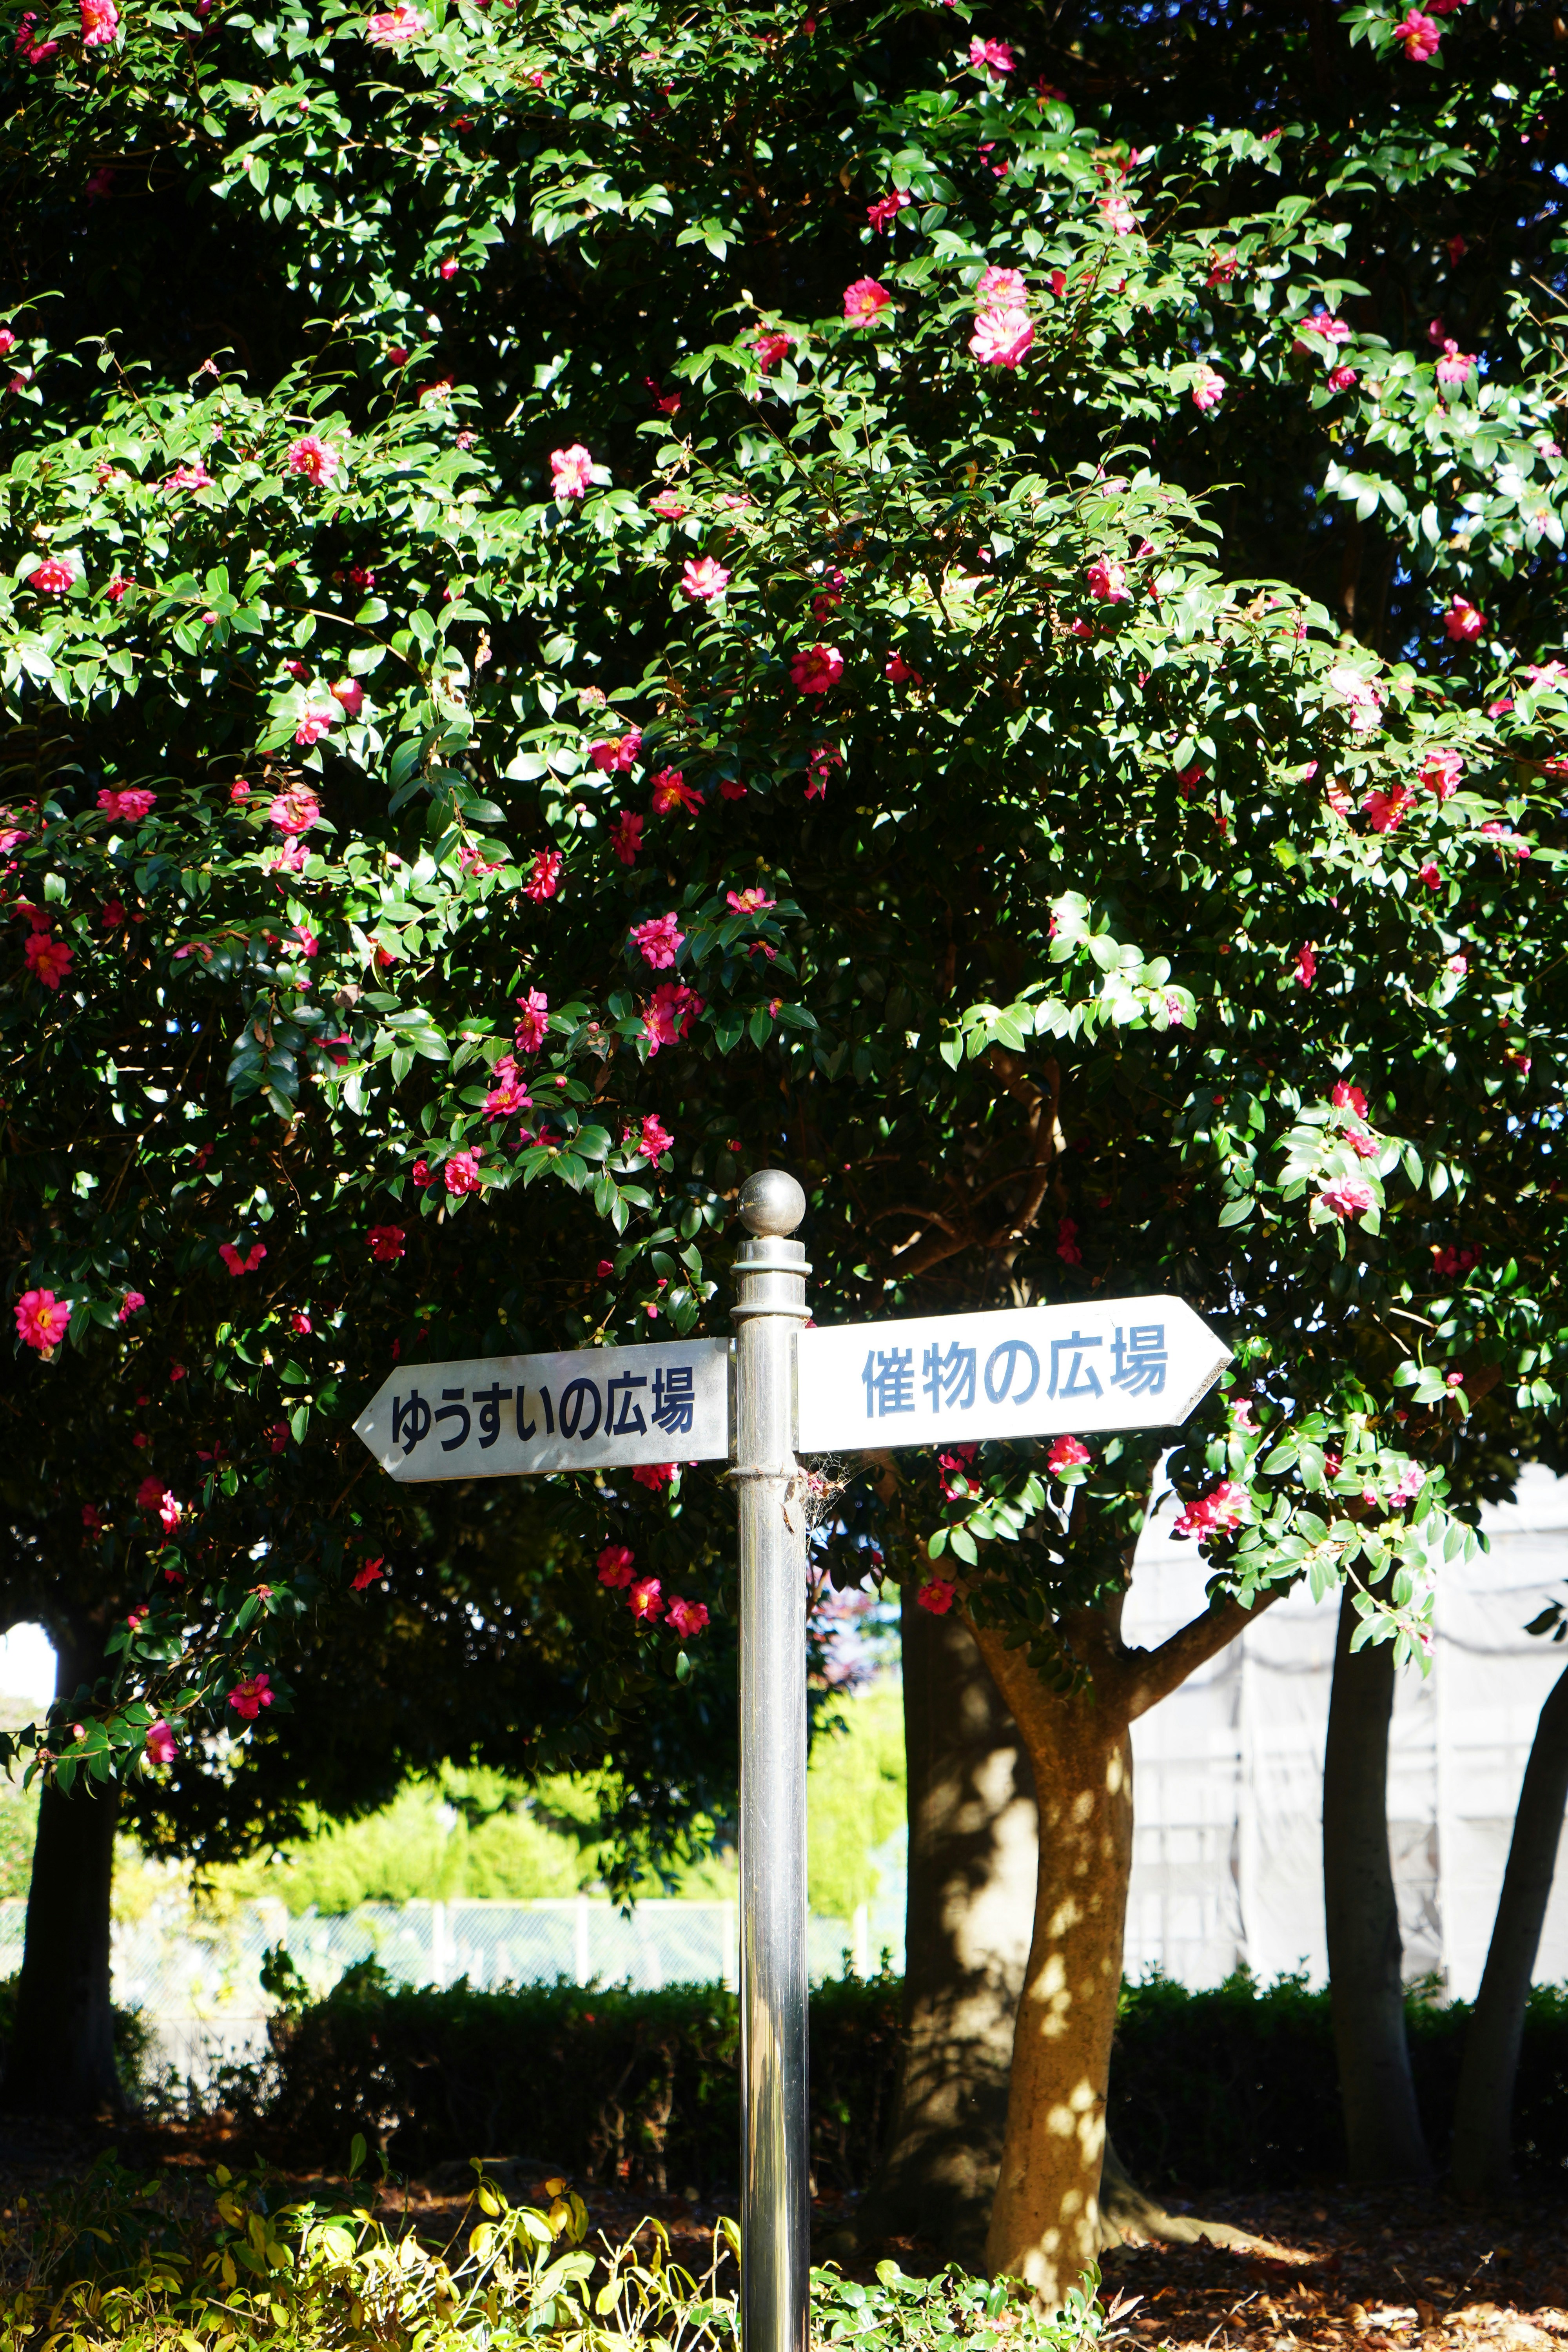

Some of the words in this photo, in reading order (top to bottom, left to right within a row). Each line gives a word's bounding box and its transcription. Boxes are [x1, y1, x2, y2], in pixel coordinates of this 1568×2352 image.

[392, 1366, 695, 1455] ゆうすいの広場
[861, 1324, 1169, 1419] 催物の広場
